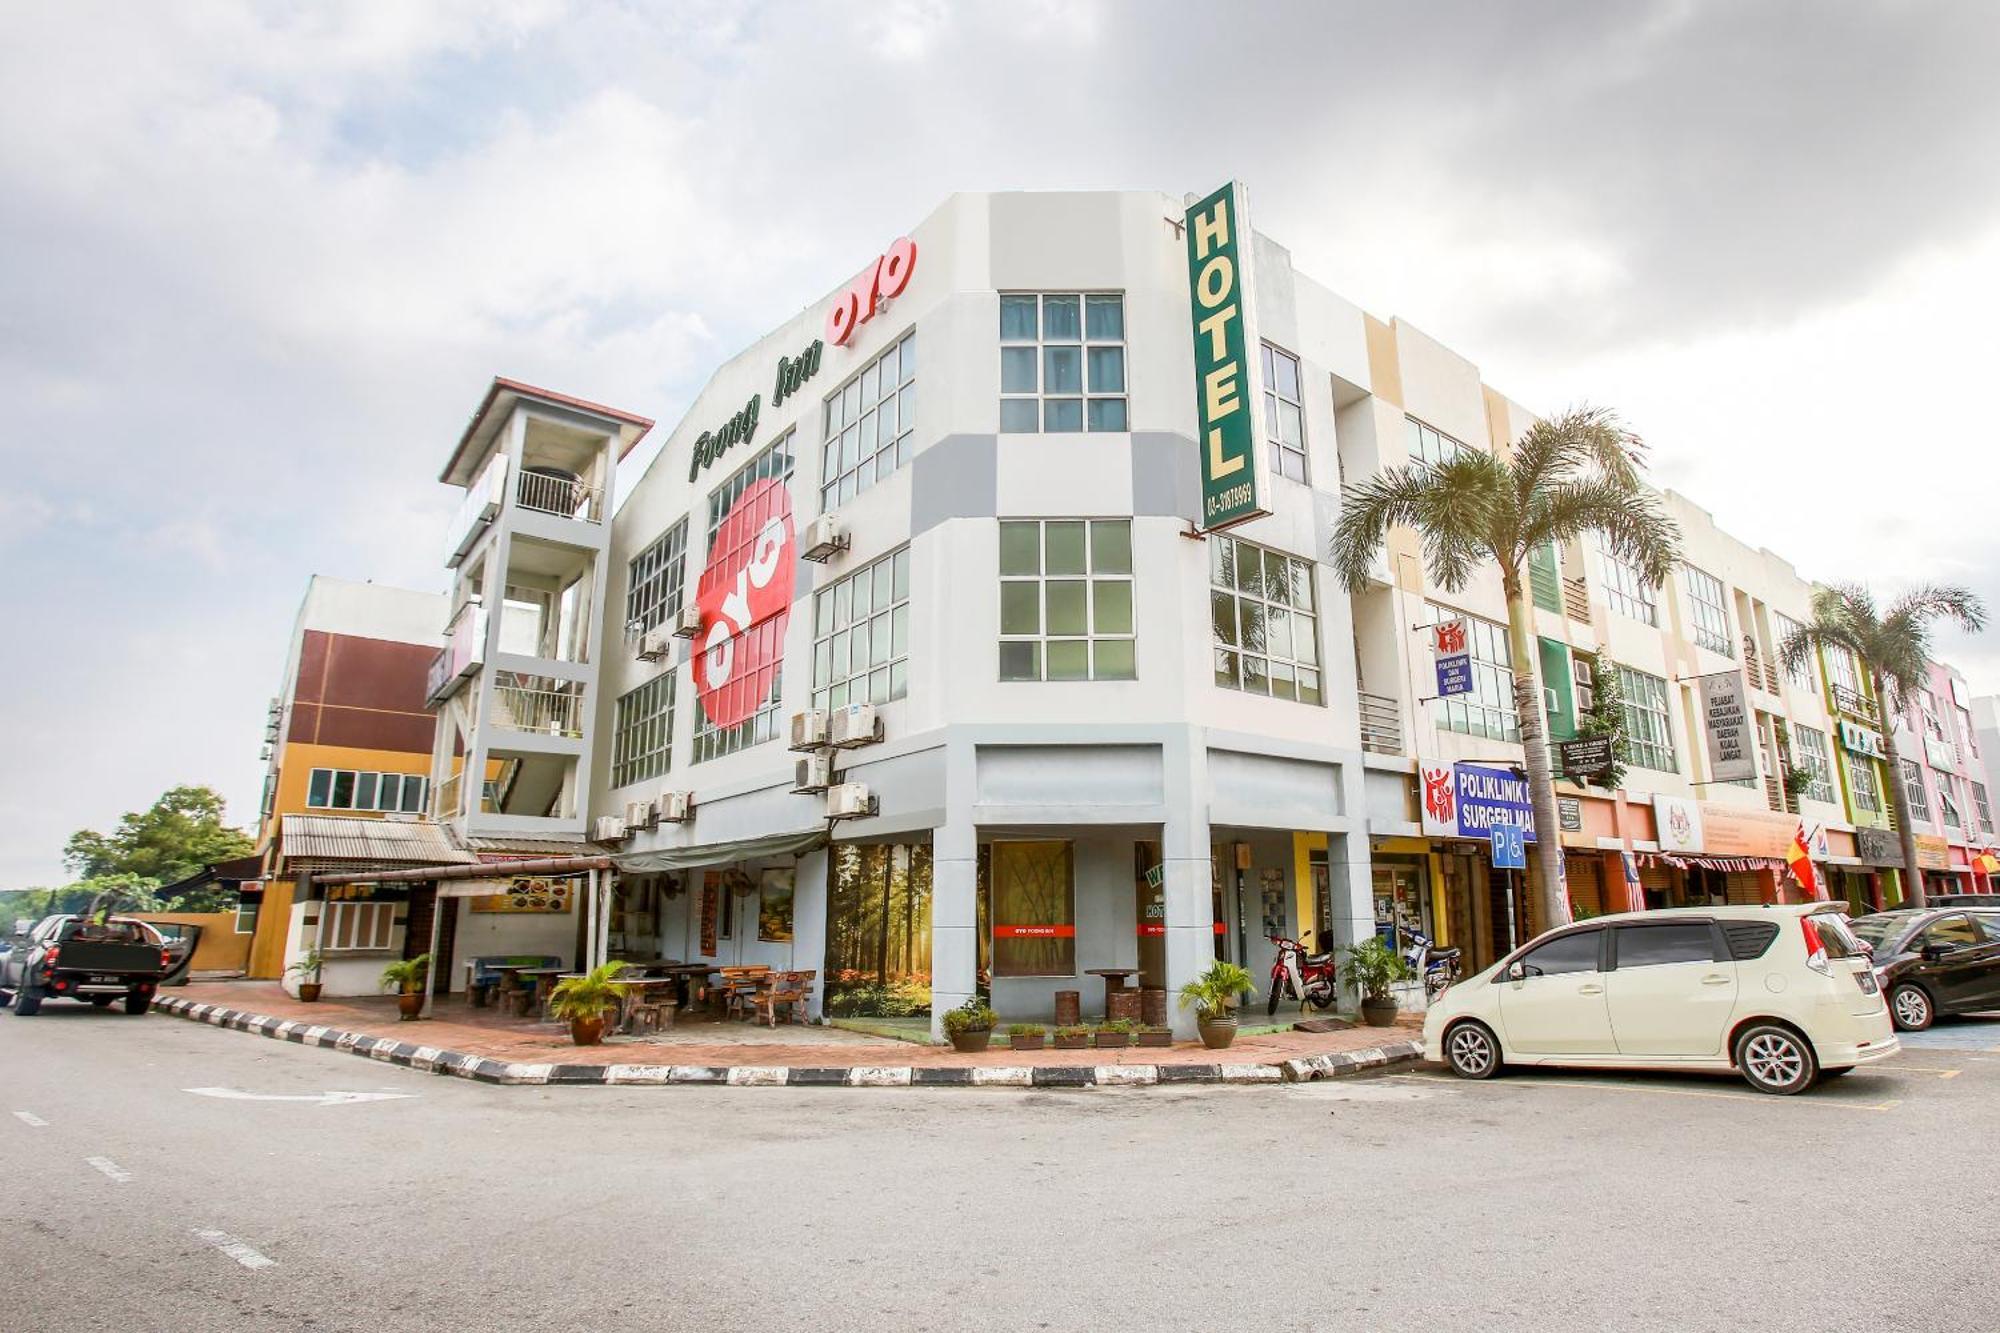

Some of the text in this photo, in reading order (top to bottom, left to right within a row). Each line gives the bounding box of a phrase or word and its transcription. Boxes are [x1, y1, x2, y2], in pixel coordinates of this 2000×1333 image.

[825, 236, 917, 346] OYO
[1194, 199, 1245, 481] HOTEL
[772, 339, 824, 408] Inn
[705, 516, 786, 690] OYO
[1438, 659, 1468, 670] POLIKLINIK
[1710, 694, 1735, 707] PEJABAT
[1709, 705, 1741, 718] KEBAJIKAN
[1707, 716, 1744, 729] MASYARAKAT
[1716, 728, 1740, 739] DAERAH
[1720, 739, 1740, 750] KUALA
[1719, 749, 1742, 761] LANGAT
[1459, 772, 1525, 804] POLIKLINIK
[1462, 803, 1513, 829] SURGERI
[1515, 809, 1536, 833] MA
[1494, 831, 1505, 859] P
